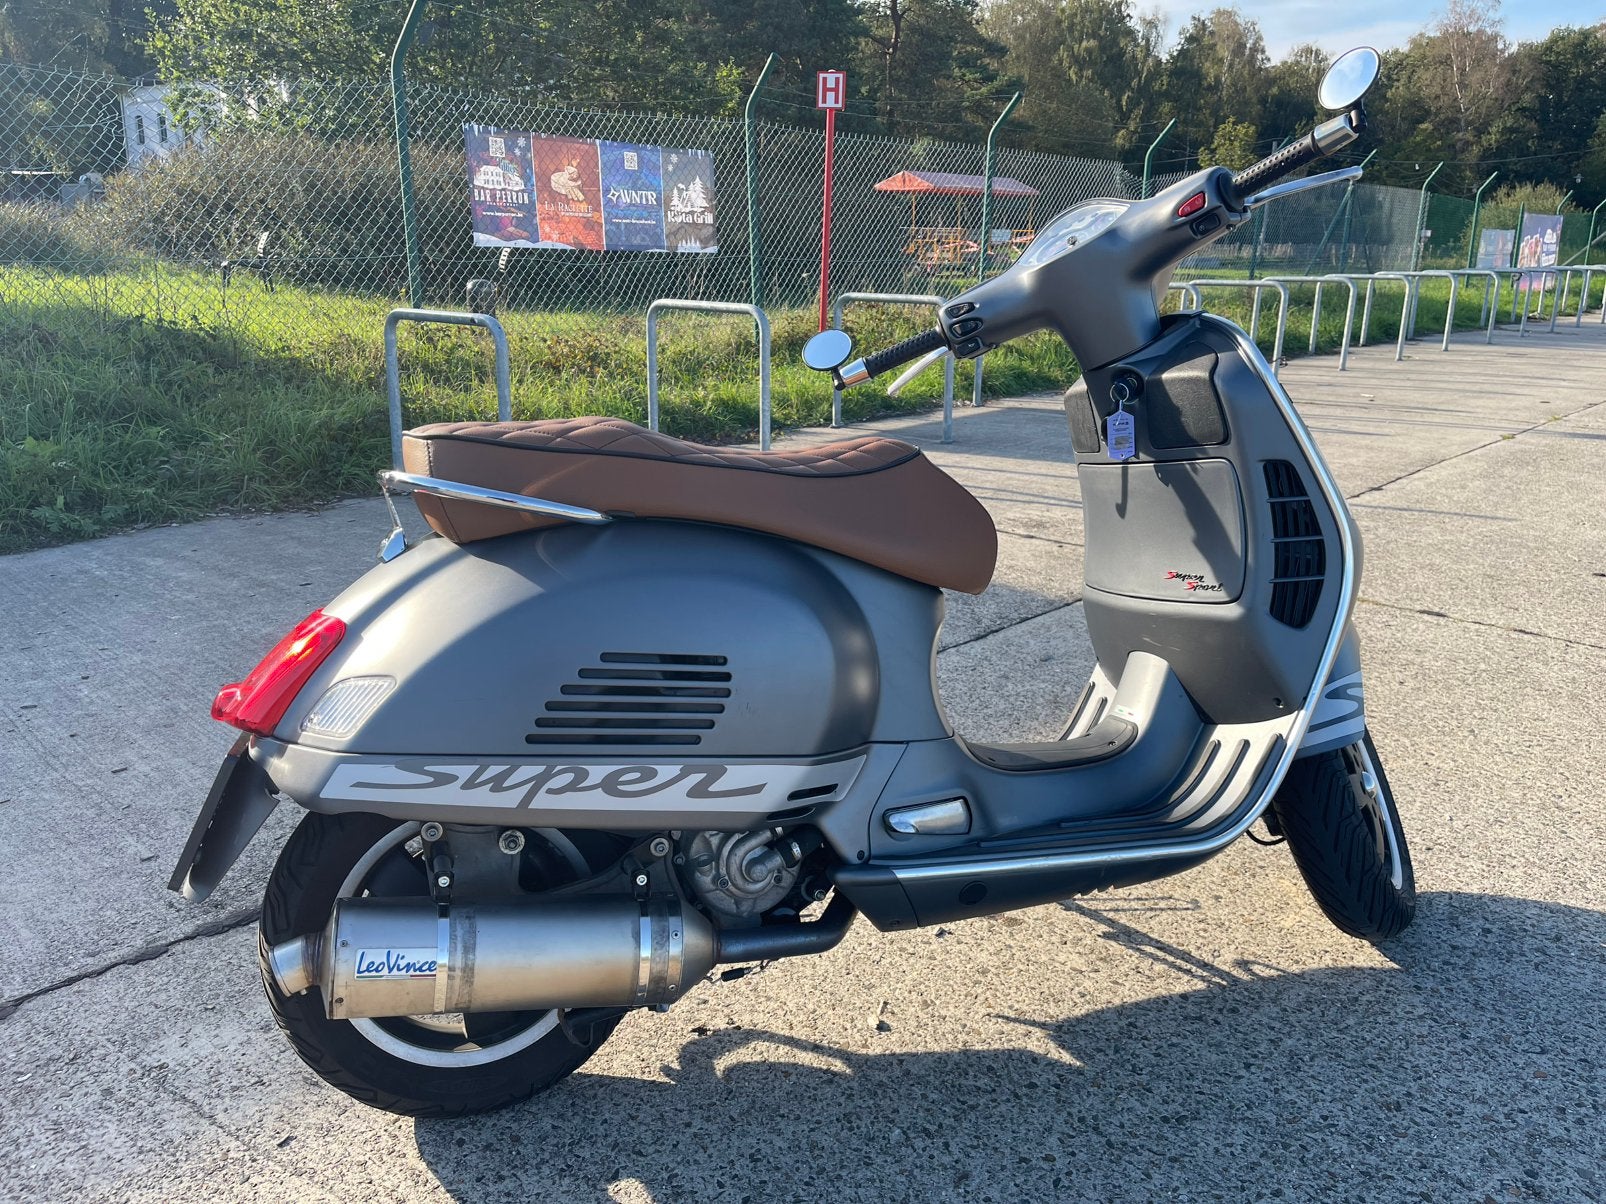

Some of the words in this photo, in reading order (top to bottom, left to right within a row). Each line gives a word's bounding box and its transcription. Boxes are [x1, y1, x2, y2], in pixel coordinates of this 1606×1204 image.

[821, 76, 841, 105] H
[474, 188, 492, 202] BAR
[496, 190, 530, 205] PERRON
[619, 189, 658, 205] WNTR
[693, 212, 714, 224] Grill
[1163, 571, 1205, 583] Super
[1183, 581, 1224, 592] Sport
[356, 949, 438, 975] LeoVince
